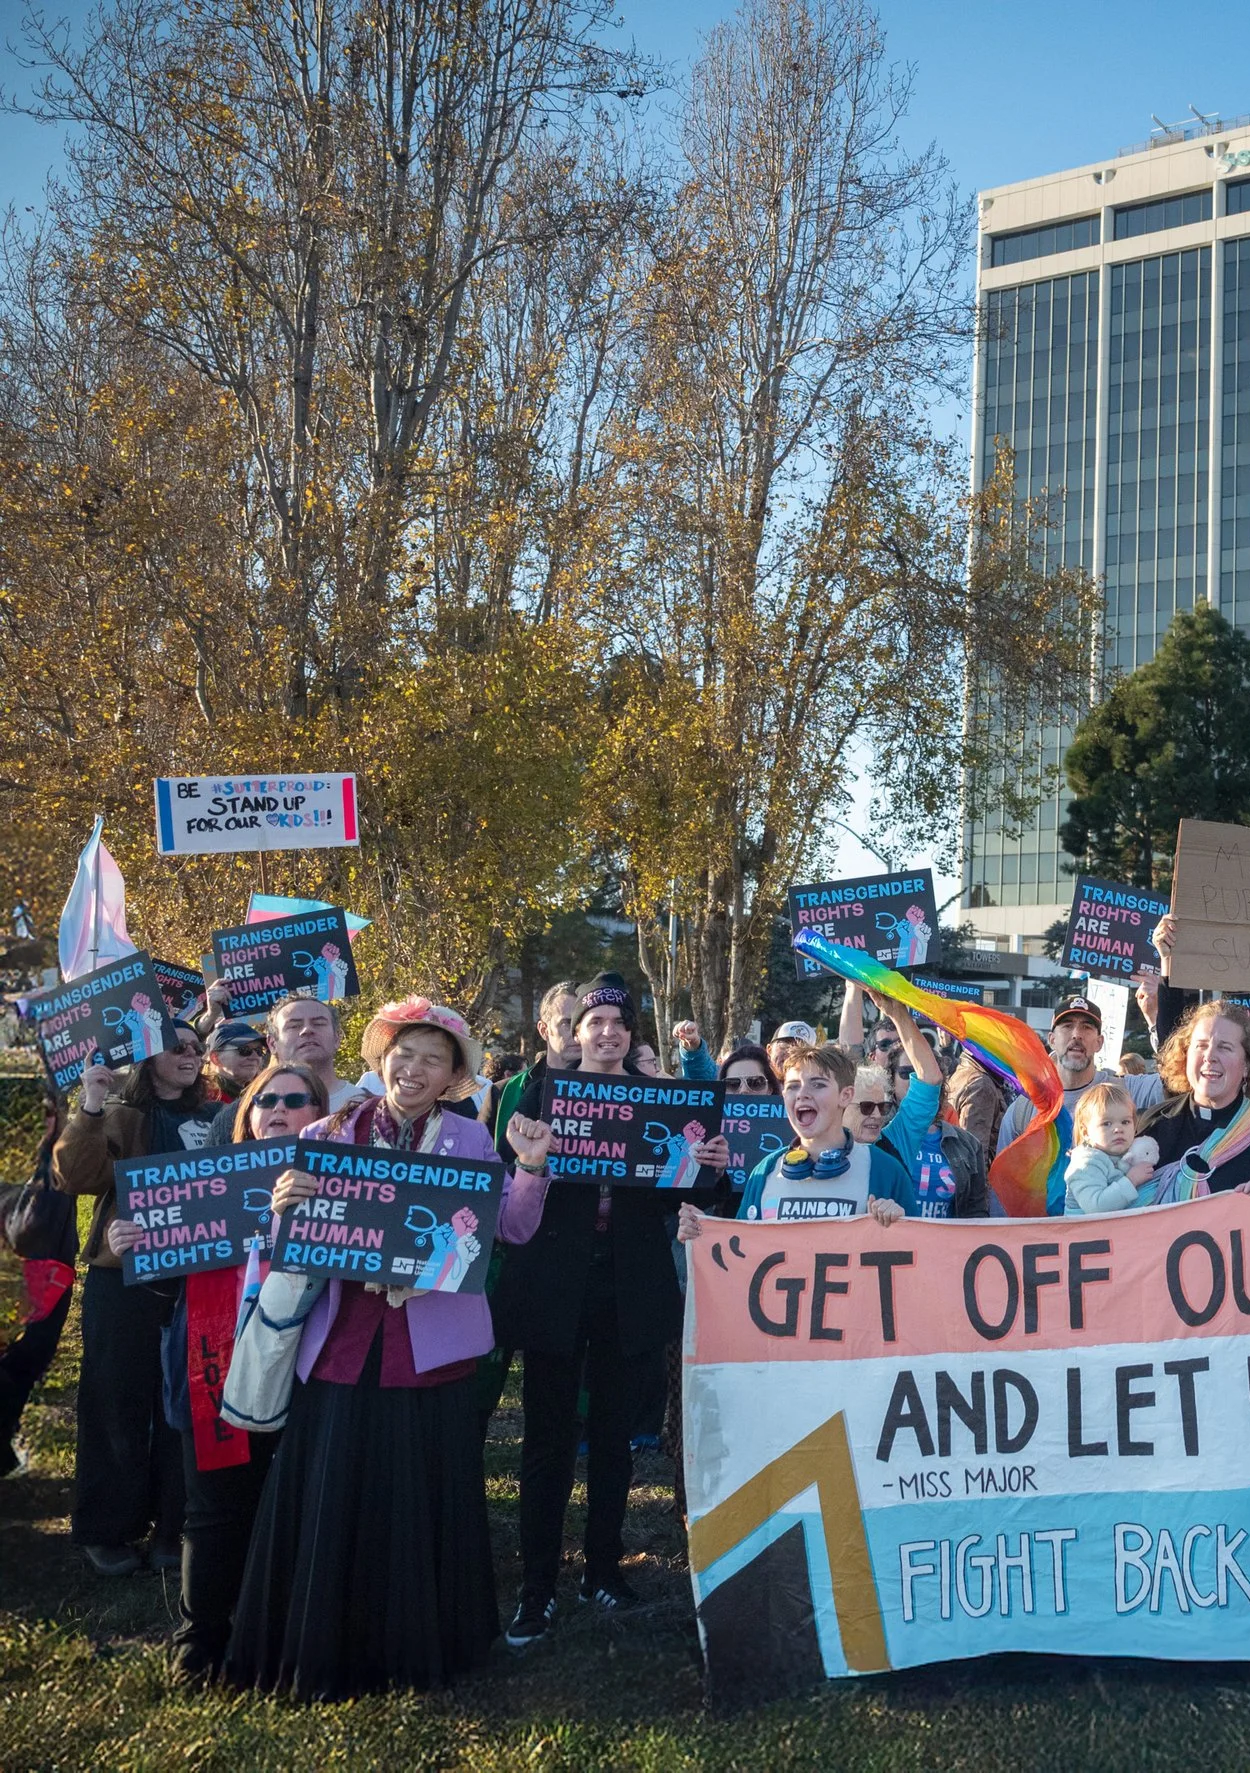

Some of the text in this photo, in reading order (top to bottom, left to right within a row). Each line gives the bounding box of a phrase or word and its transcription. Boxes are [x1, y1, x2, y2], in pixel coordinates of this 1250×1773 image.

[178, 782, 201, 799] BE
[208, 796, 306, 815] STAND UP
[186, 817, 223, 834] FOR
[224, 816, 262, 830] OUR
[796, 878, 926, 908] TRANSGENDER
[1083, 885, 1169, 916] TRANSGEN
[798, 903, 865, 924] RIGHTS
[1075, 917, 1111, 935] ARE
[1079, 901, 1141, 926] RIGHTS
[219, 916, 339, 951] TRANSGENDER
[1073, 932, 1135, 957] HUMAN
[221, 944, 281, 967] RIGHTS
[972, 952, 1000, 963] TOWERS
[1070, 948, 1134, 973] RIGHTS
[153, 963, 205, 985] TRANSGEN
[156, 974, 184, 988] GHTS
[224, 964, 255, 981] ARE
[224, 973, 285, 996] HUMAN
[582, 988, 627, 1005] SPOOKY
[915, 978, 980, 995] TRANSGENDER
[587, 993, 623, 1008] BITCH
[50, 1036, 98, 1071] HUMAN
[55, 1052, 105, 1087] RIGHS
[554, 1079, 715, 1106] TRANSGENDER
[551, 1099, 634, 1121] RIGHTS
[551, 1118, 593, 1137] ARE
[126, 1145, 296, 1188] TRANSGENDE
[305, 1151, 492, 1192] TRANSGENDER
[546, 1155, 627, 1177] RIGHTS
[129, 1178, 228, 1210] RIGHTS
[314, 1176, 396, 1203] IGHTS
[132, 1206, 183, 1229] ARE
[293, 1198, 348, 1221] ARE
[781, 1201, 853, 1216] RAINBOW
[133, 1219, 227, 1253] HUMAN
[289, 1220, 384, 1249] HUMAN
[134, 1240, 233, 1274] RIGHTS
[283, 1243, 383, 1272] RIGHTS
[962, 1238, 1112, 1342] OFF
[875, 1367, 1041, 1463] AND
[1066, 1356, 1211, 1459] LET
[964, 1464, 1039, 1496] MAJOR
[898, 1527, 1078, 1623] FIGHT
